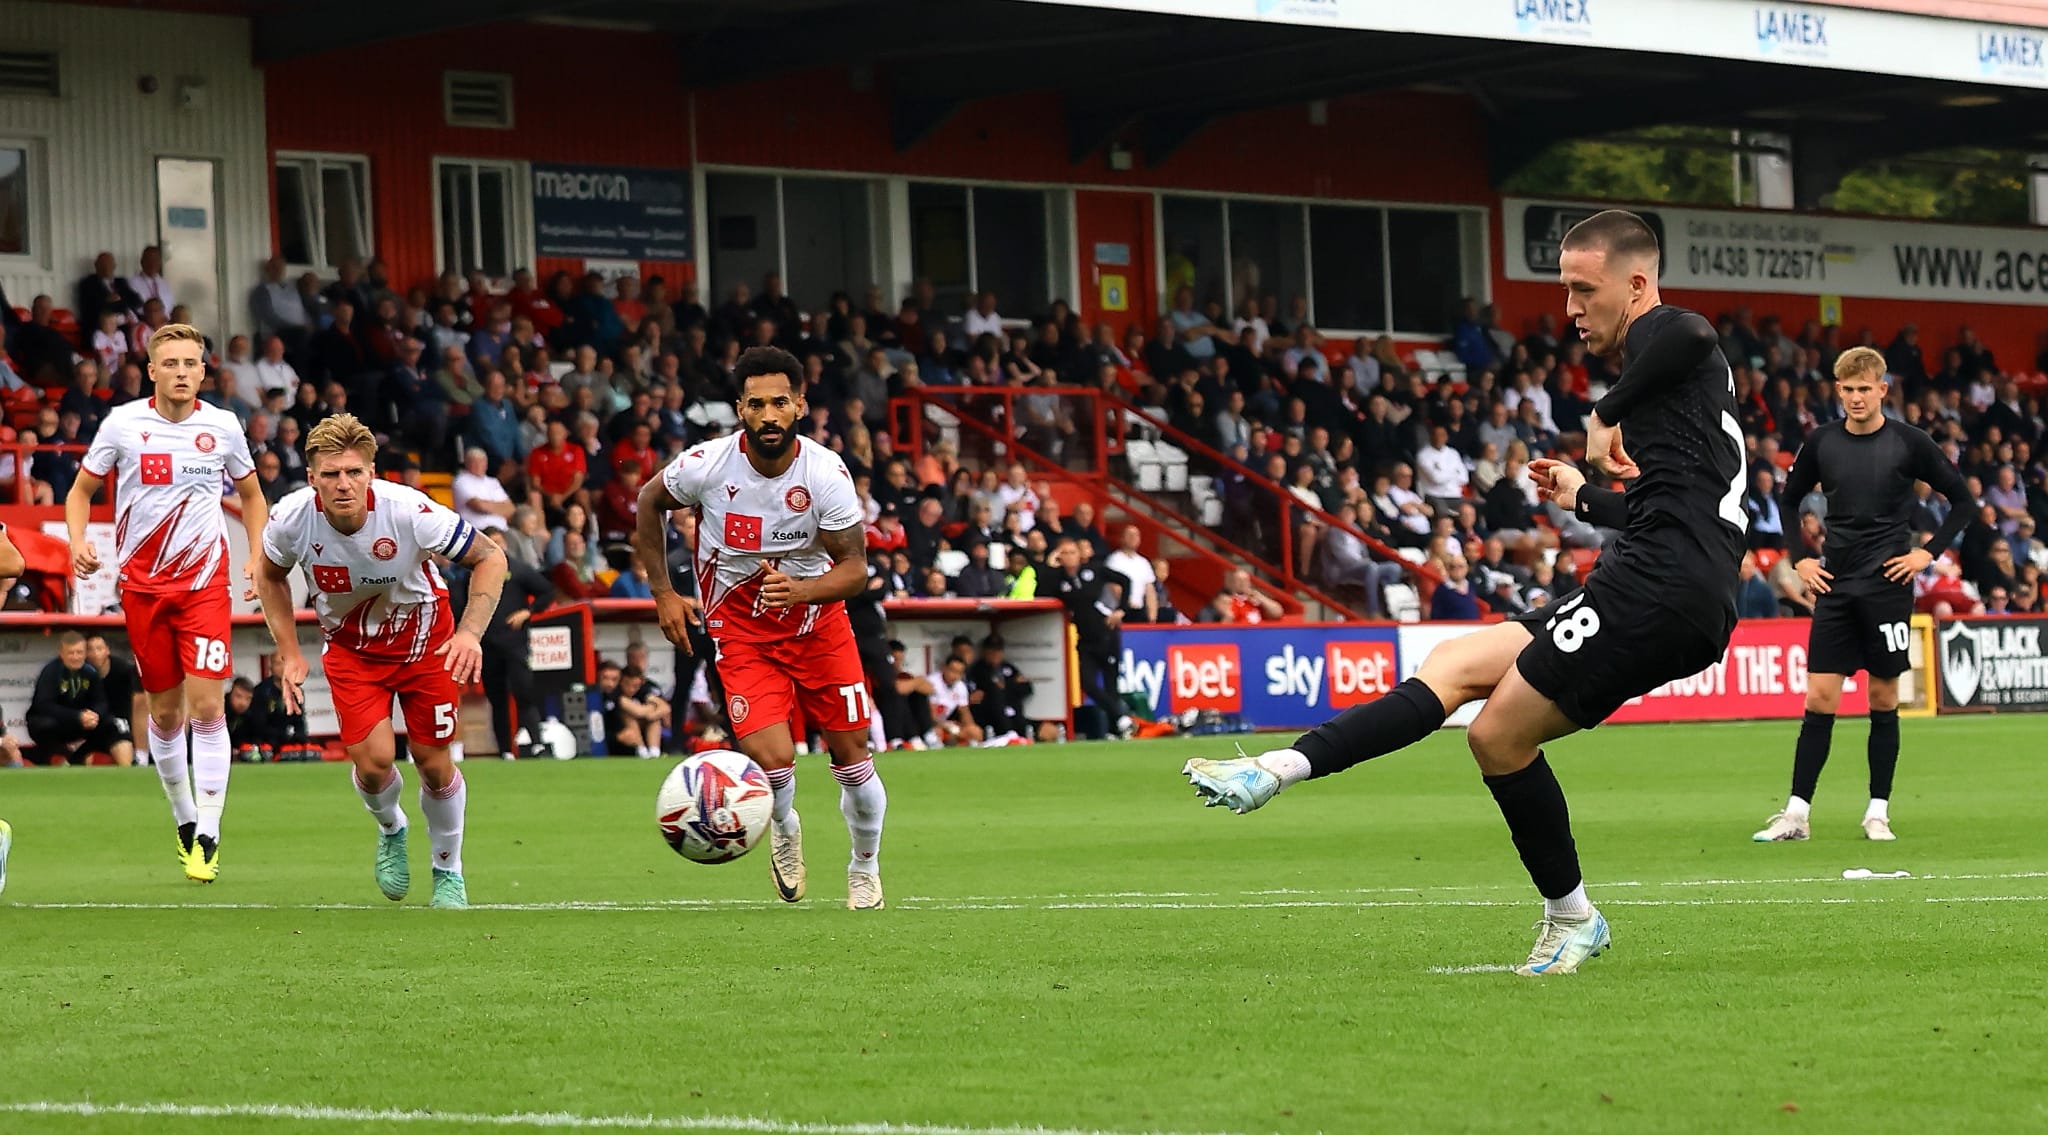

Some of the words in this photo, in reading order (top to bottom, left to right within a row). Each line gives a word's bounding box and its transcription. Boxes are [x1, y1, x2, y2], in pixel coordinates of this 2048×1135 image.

[1514, 0, 1592, 25] LAMEX
[1754, 8, 1828, 47] LAMEX
[1976, 30, 2044, 68] LAMEX
[536, 171, 631, 201] macron
[181, 465, 212, 475] Xsolla
[772, 530, 809, 541] Xsolla
[361, 575, 398, 586] Xsolla
[194, 635, 227, 673] 18
[1879, 621, 1910, 653] 10
[1980, 626, 2042, 658] BLACK
[535, 650, 570, 664] TEAM
[1173, 649, 1237, 699] bet
[1735, 646, 1785, 694] THE
[1265, 643, 1325, 707] sky
[1331, 647, 1392, 694] bet
[839, 681, 870, 722] 11
[434, 702, 454, 739] 5
